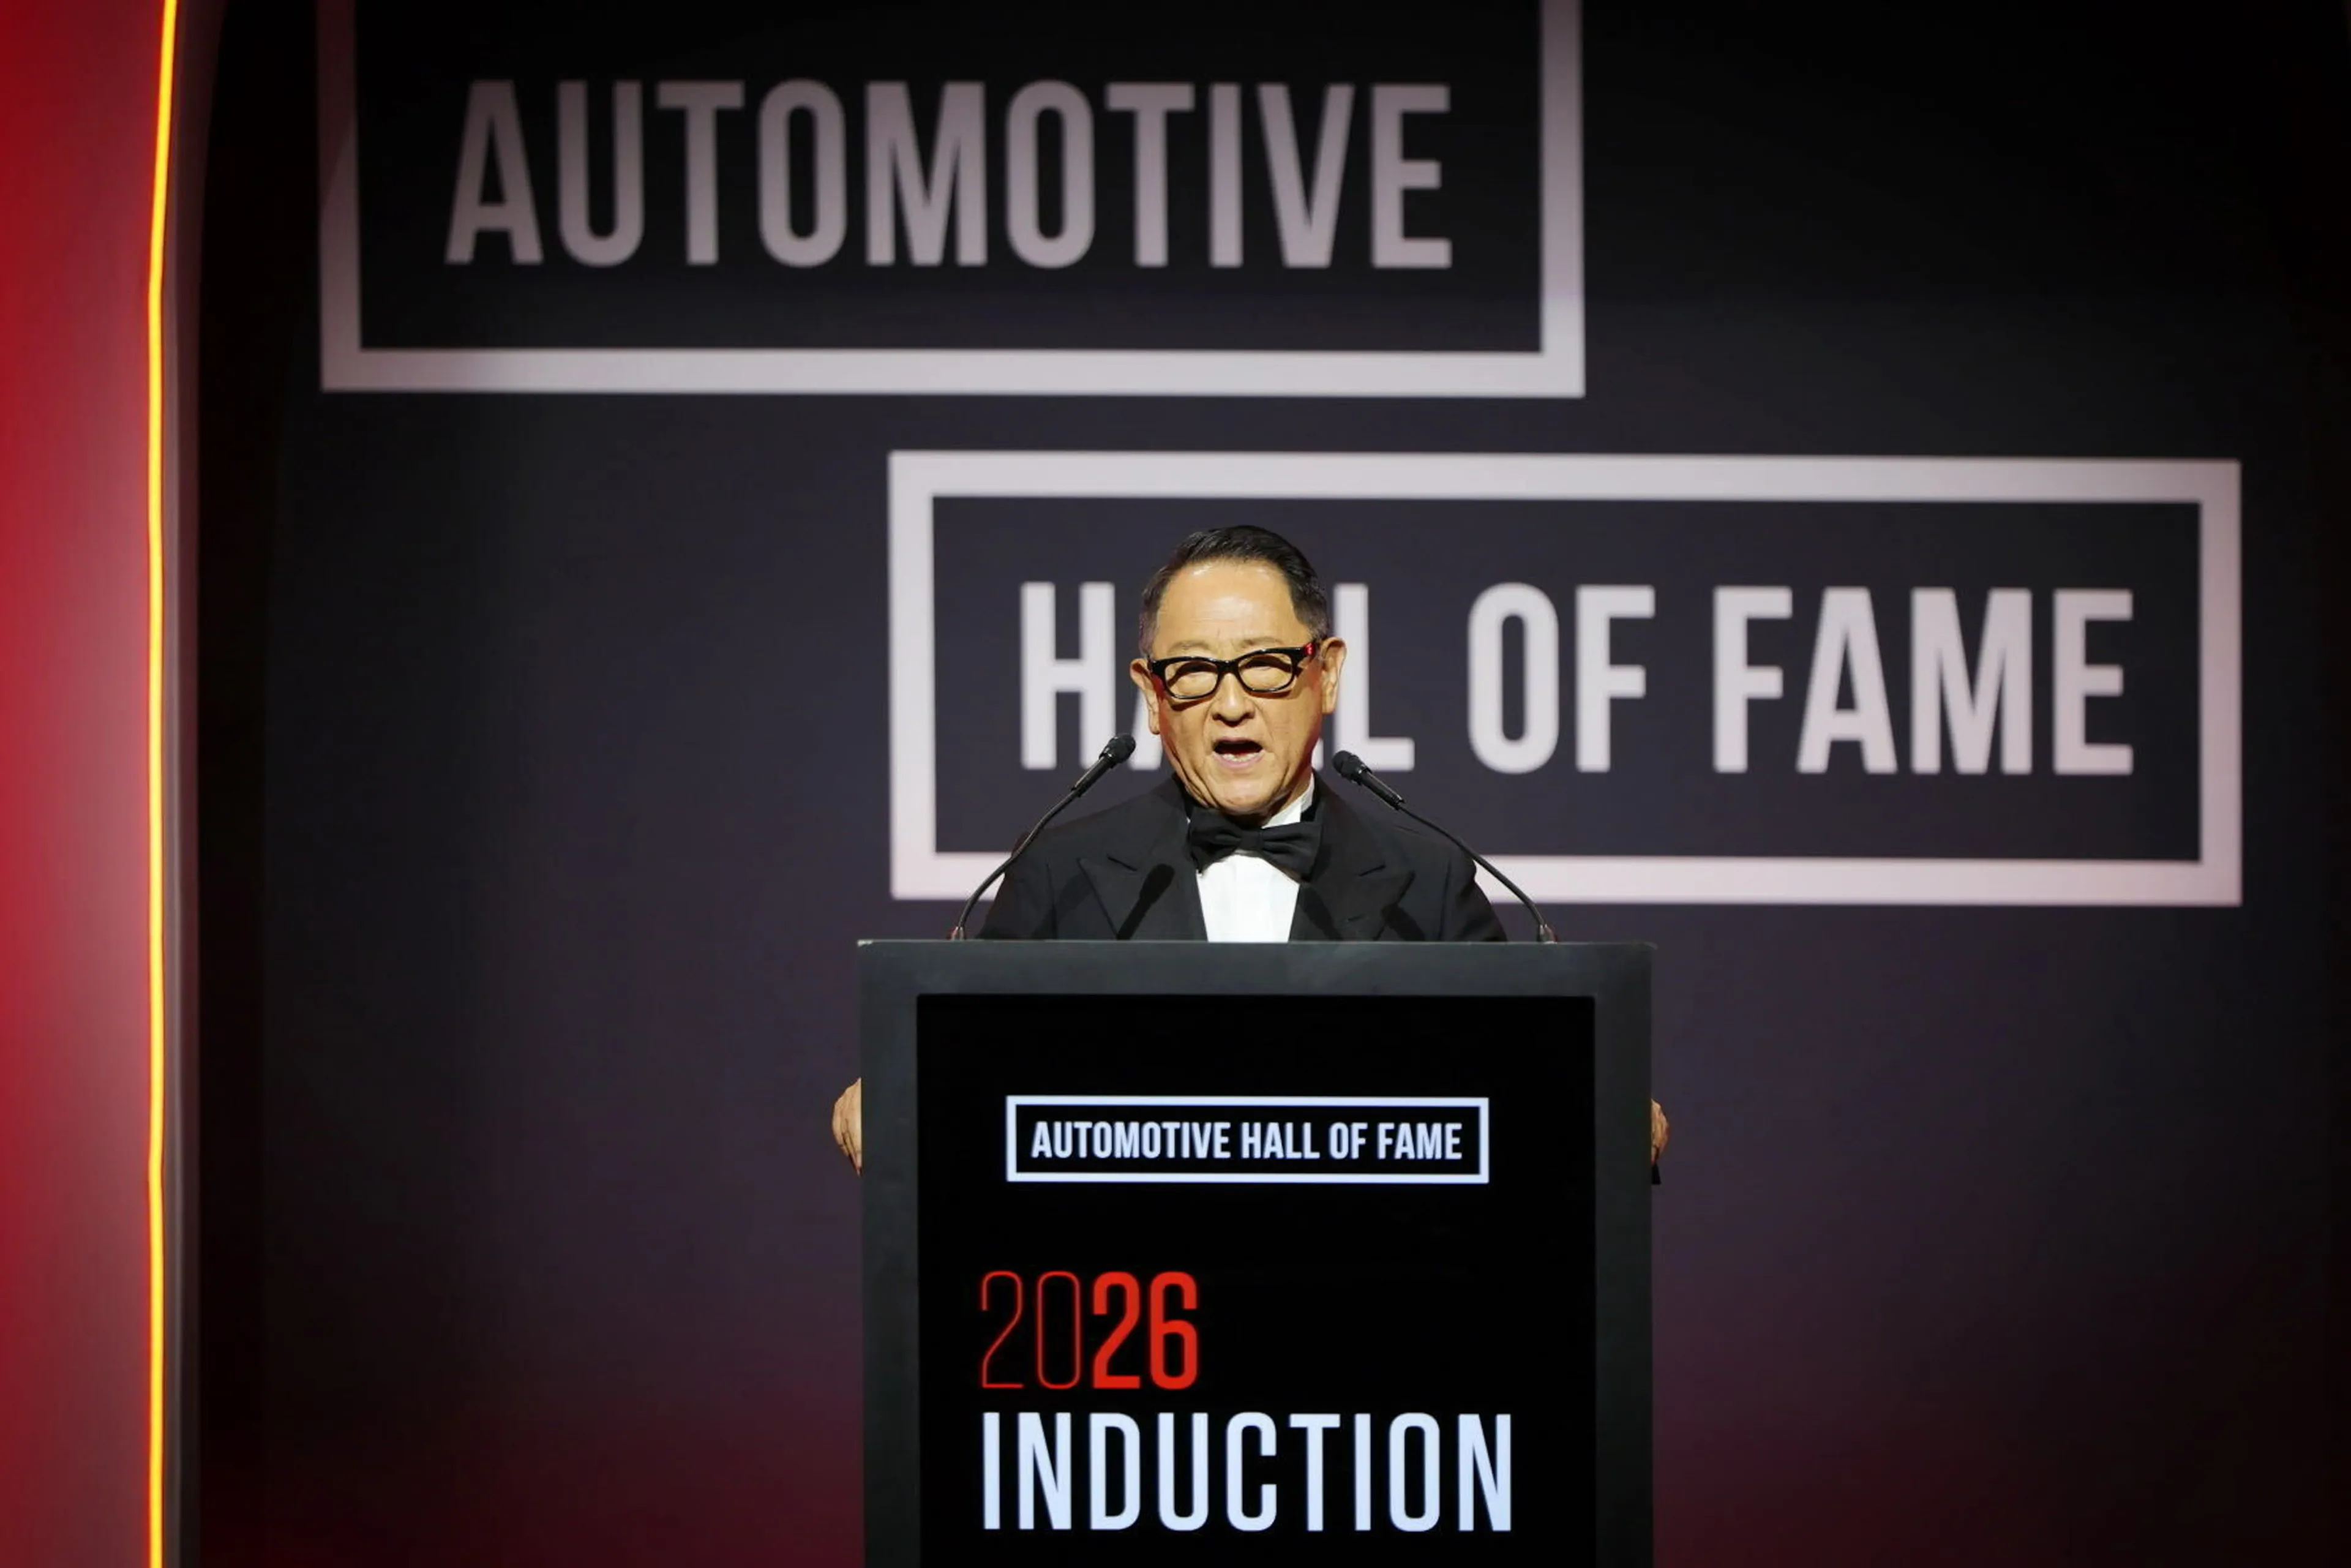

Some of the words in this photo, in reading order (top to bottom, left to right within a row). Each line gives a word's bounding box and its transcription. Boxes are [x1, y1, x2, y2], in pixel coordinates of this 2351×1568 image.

[447, 81, 1453, 269] AUTOMOTIVE
[1021, 582, 1415, 772] HL
[1468, 583, 1655, 774] OF
[1714, 587, 2133, 775] FAME
[1032, 1121, 1232, 1158] AUTOMOTIVE
[1242, 1122, 1321, 1159] HALL
[1330, 1122, 1368, 1159] OF
[1378, 1122, 1463, 1160] FAME
[981, 1270, 1198, 1390] 2026
[983, 1412, 1511, 1532] INDUCTION
